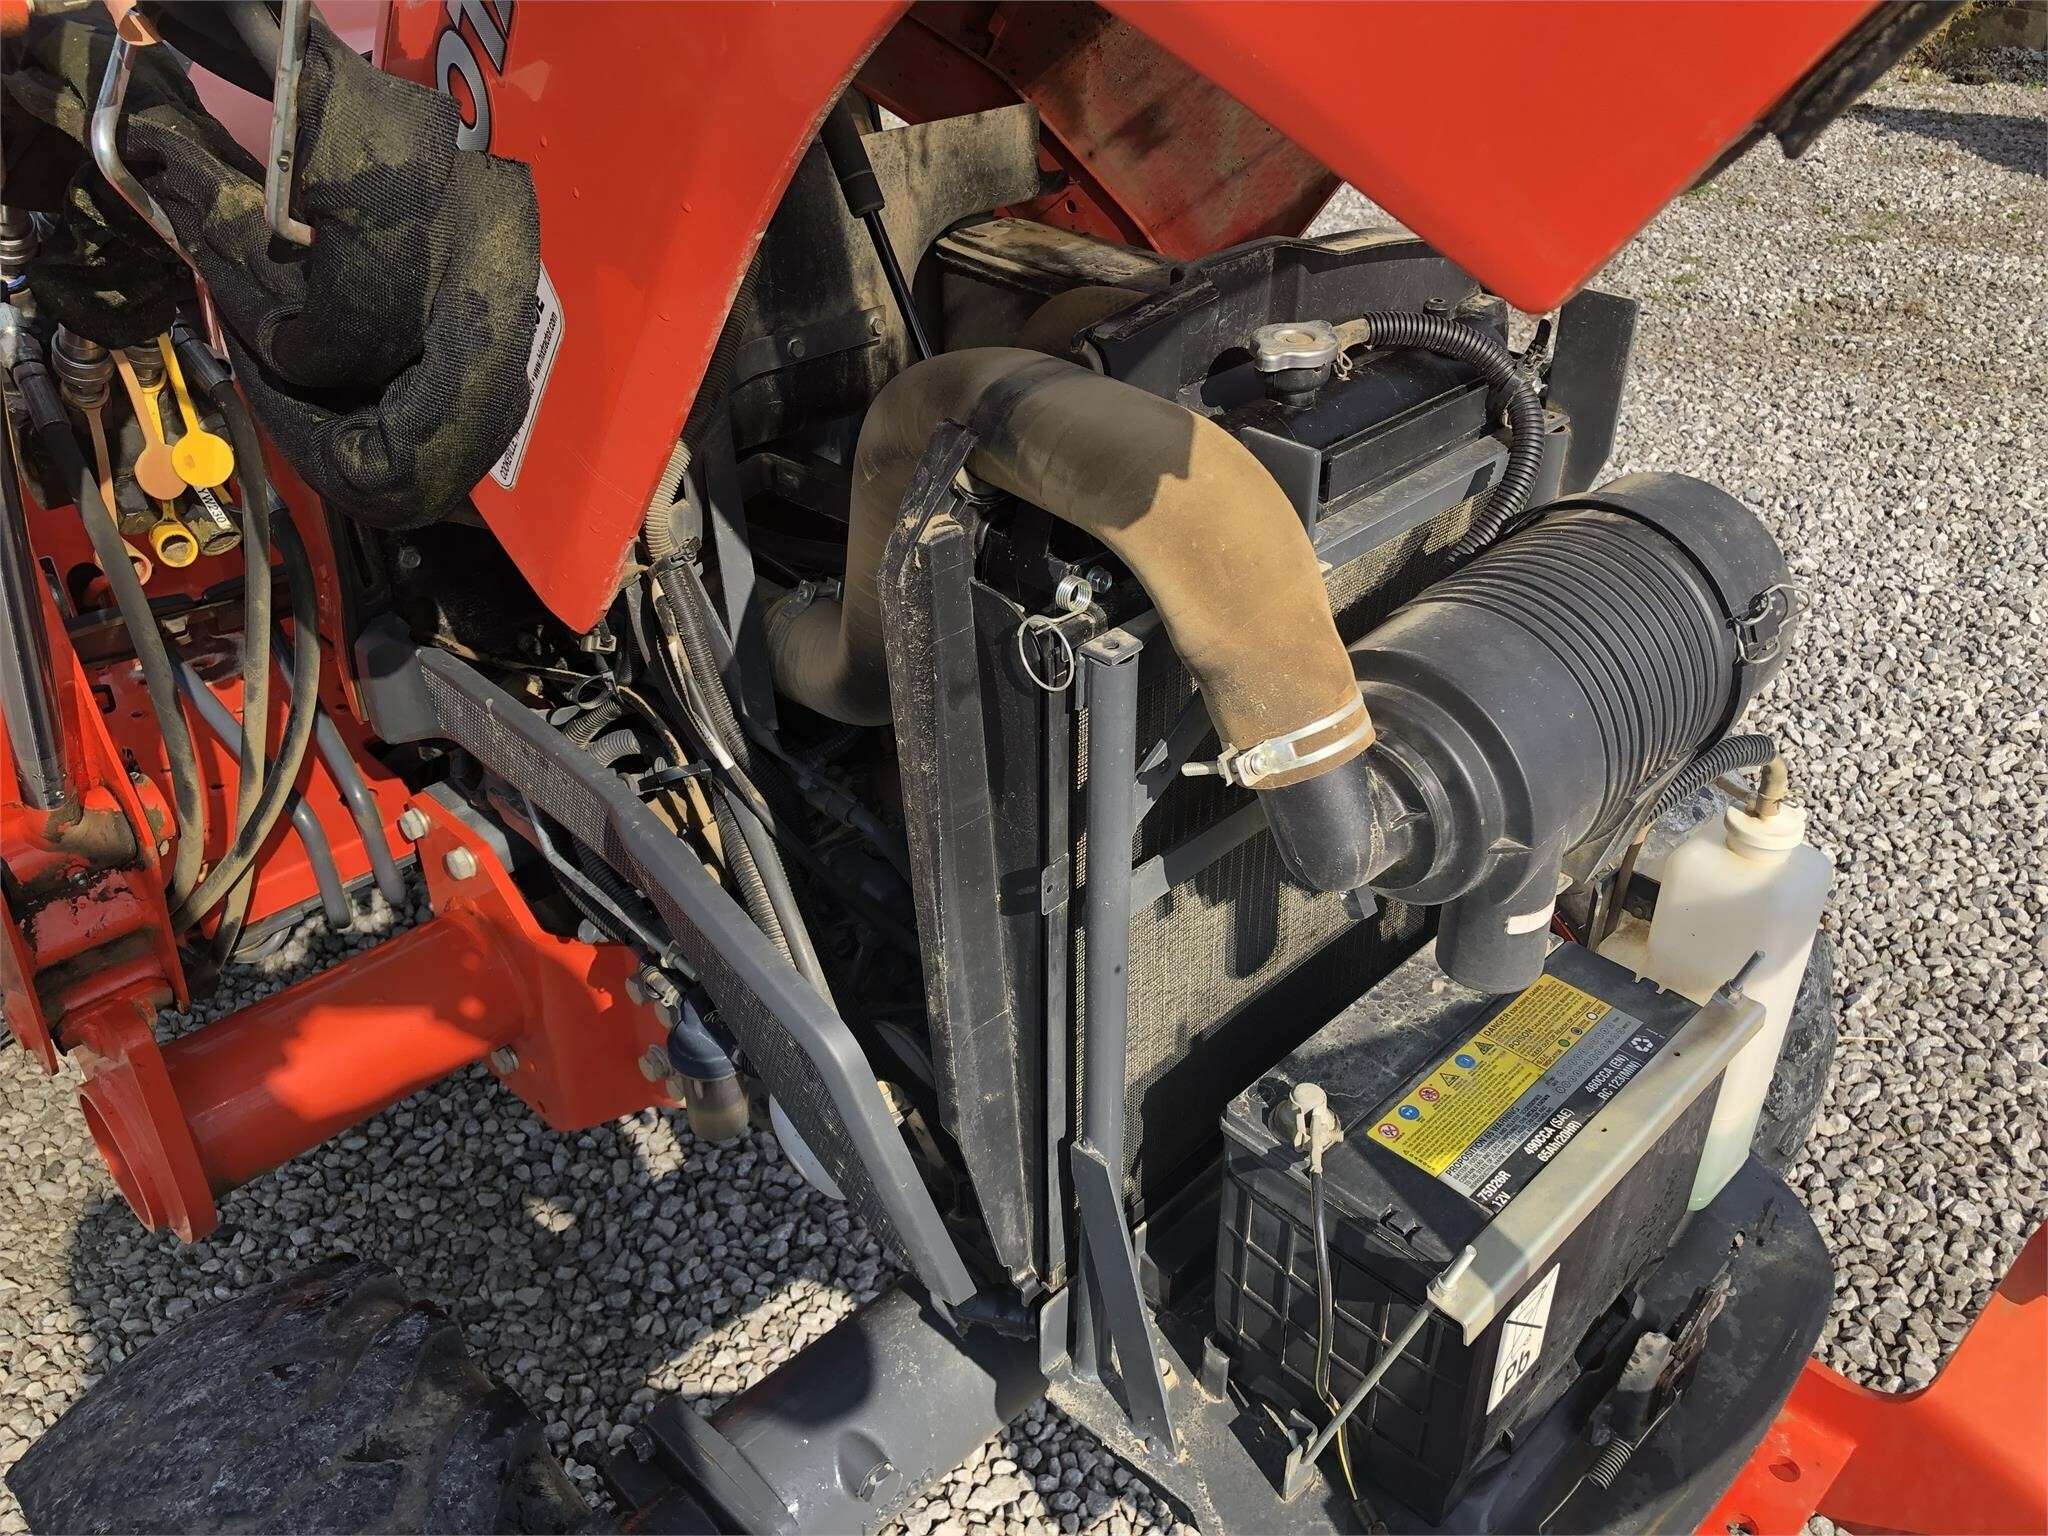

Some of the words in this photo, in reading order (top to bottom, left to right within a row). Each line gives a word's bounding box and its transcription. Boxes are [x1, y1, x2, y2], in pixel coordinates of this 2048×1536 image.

[1482, 1012, 1512, 1037] DANGER
[1507, 1027, 1534, 1050] POISON
[1583, 1066, 1616, 1094] 460CCA
[1607, 1052, 1630, 1071] (EN)
[1598, 1087, 1614, 1100] RC
[1606, 1059, 1641, 1090] 123(MIN)
[1445, 1137, 1487, 1177] PROPOSITION
[1483, 1130, 1495, 1139] 65
[1489, 1105, 1520, 1133] WARNING
[1522, 1125, 1556, 1156] 490CCA
[1548, 1106, 1576, 1130] (SAE)
[1536, 1119, 1583, 1163] 65Ah(20HR)
[1476, 1170, 1512, 1202] 75D26R
[1490, 1190, 1512, 1209] 12V
[1501, 1351, 1530, 1395] Pb
